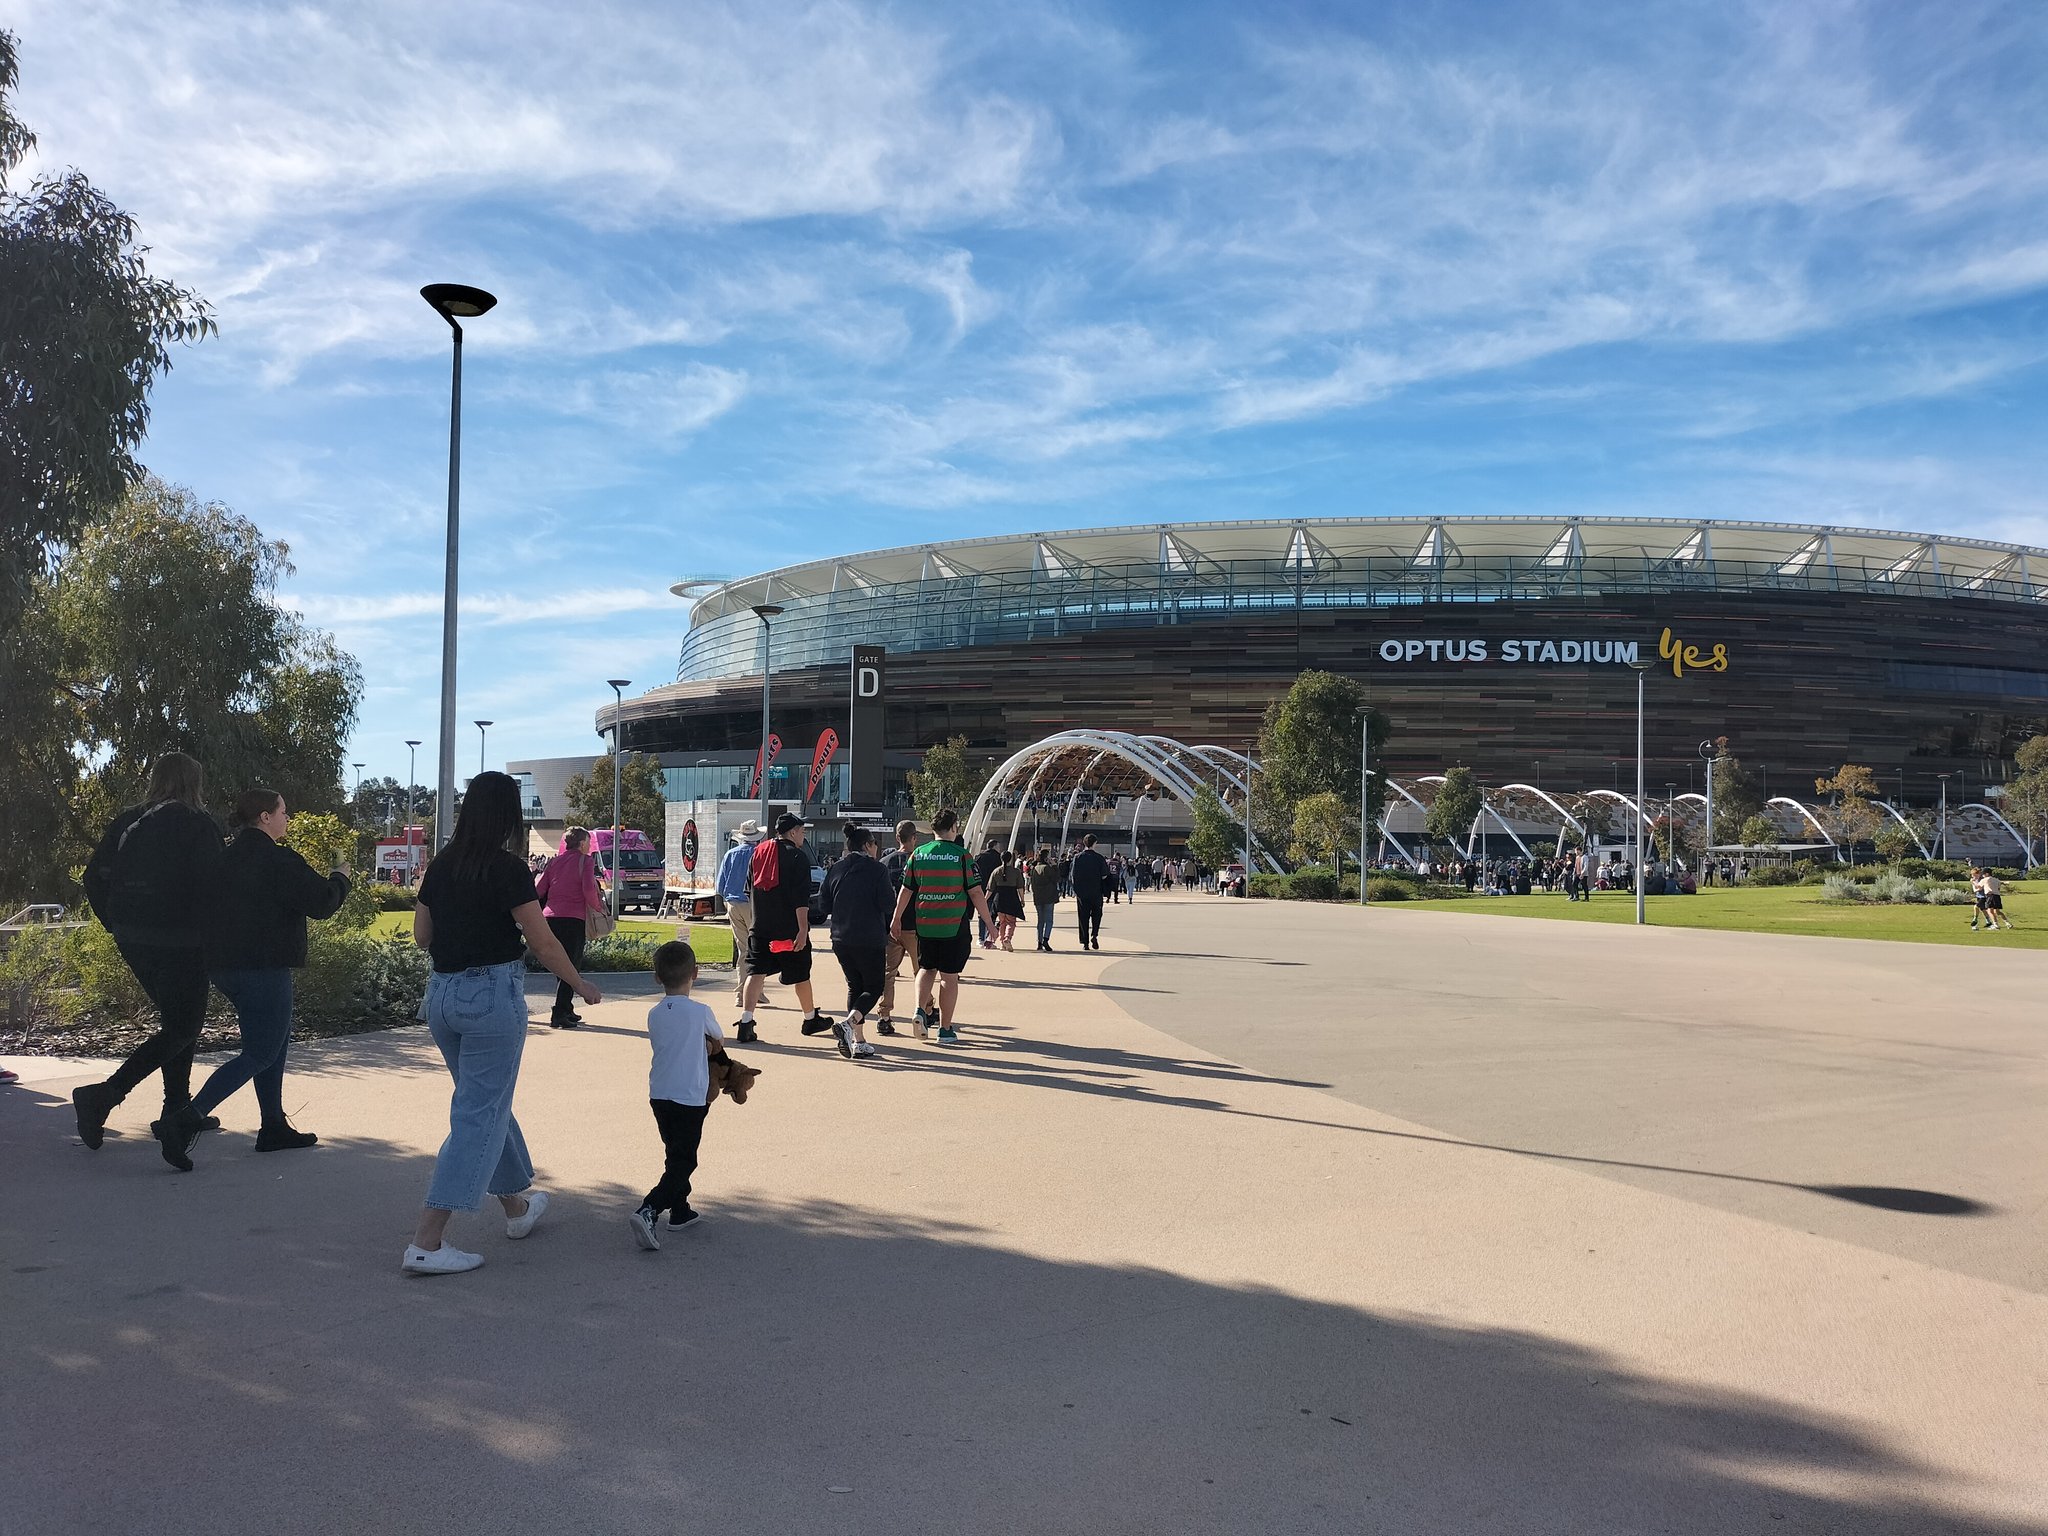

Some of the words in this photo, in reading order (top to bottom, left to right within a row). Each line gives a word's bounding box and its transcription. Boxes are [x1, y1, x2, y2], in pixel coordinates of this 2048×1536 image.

[1379, 640, 1488, 662] OPTUS
[1500, 640, 1638, 662] STADIUM
[859, 668, 879, 697] D
[811, 734, 836, 785] DONUTS
[923, 853, 960, 862] Menulog
[1109, 864, 1117, 872] 12
